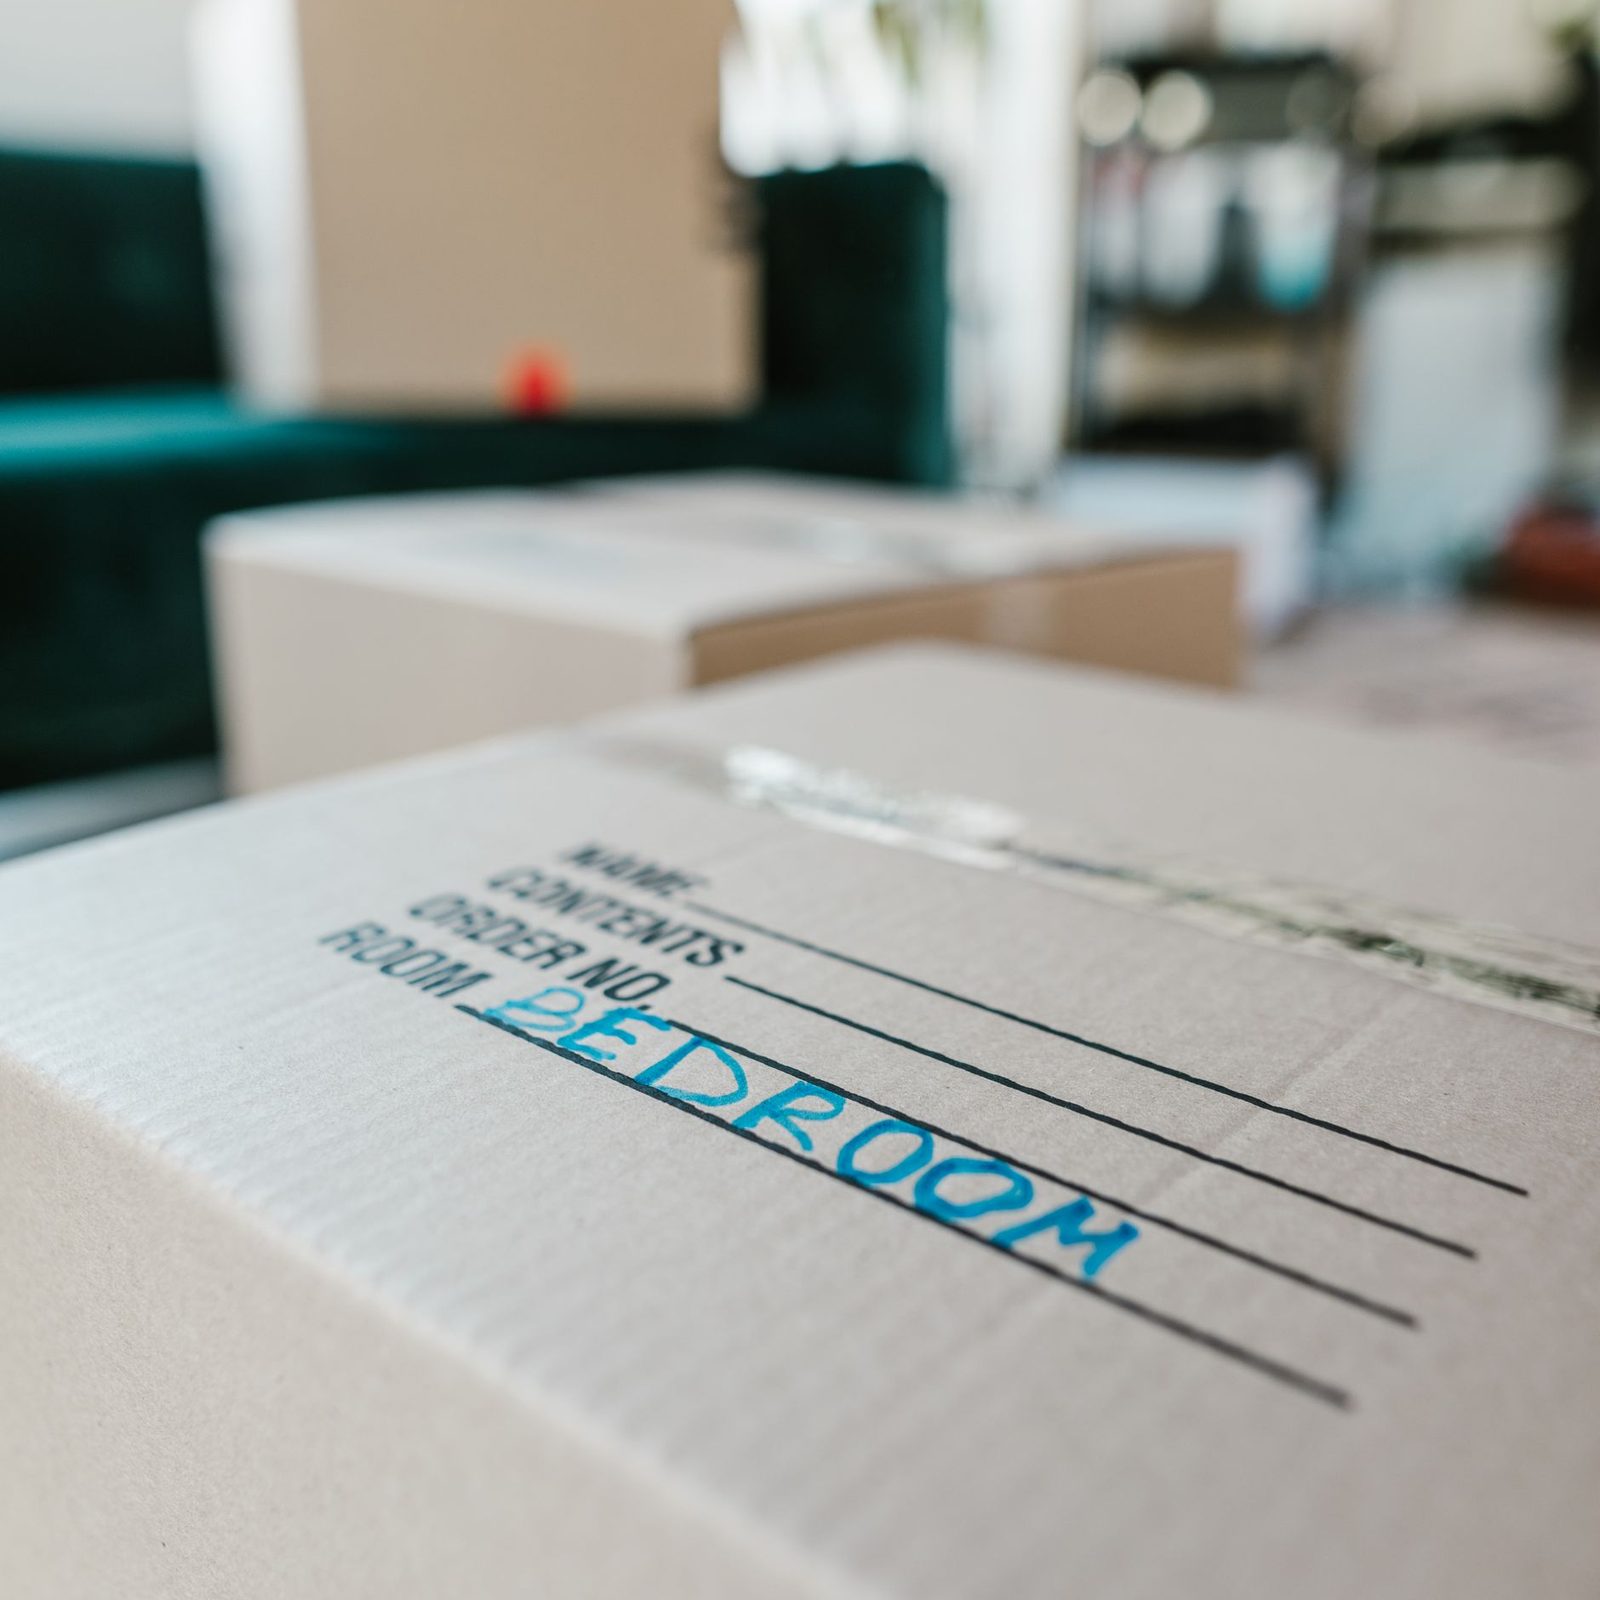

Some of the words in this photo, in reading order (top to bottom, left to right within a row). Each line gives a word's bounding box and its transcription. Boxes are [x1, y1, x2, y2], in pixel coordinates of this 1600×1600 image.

[487, 867, 745, 967] CONTENTS
[561, 840, 709, 897] NAME
[318, 922, 494, 997] ROOM
[407, 893, 588, 970] ORDER
[566, 957, 671, 1011] NO.
[483, 986, 1139, 1280] BEDROOM
